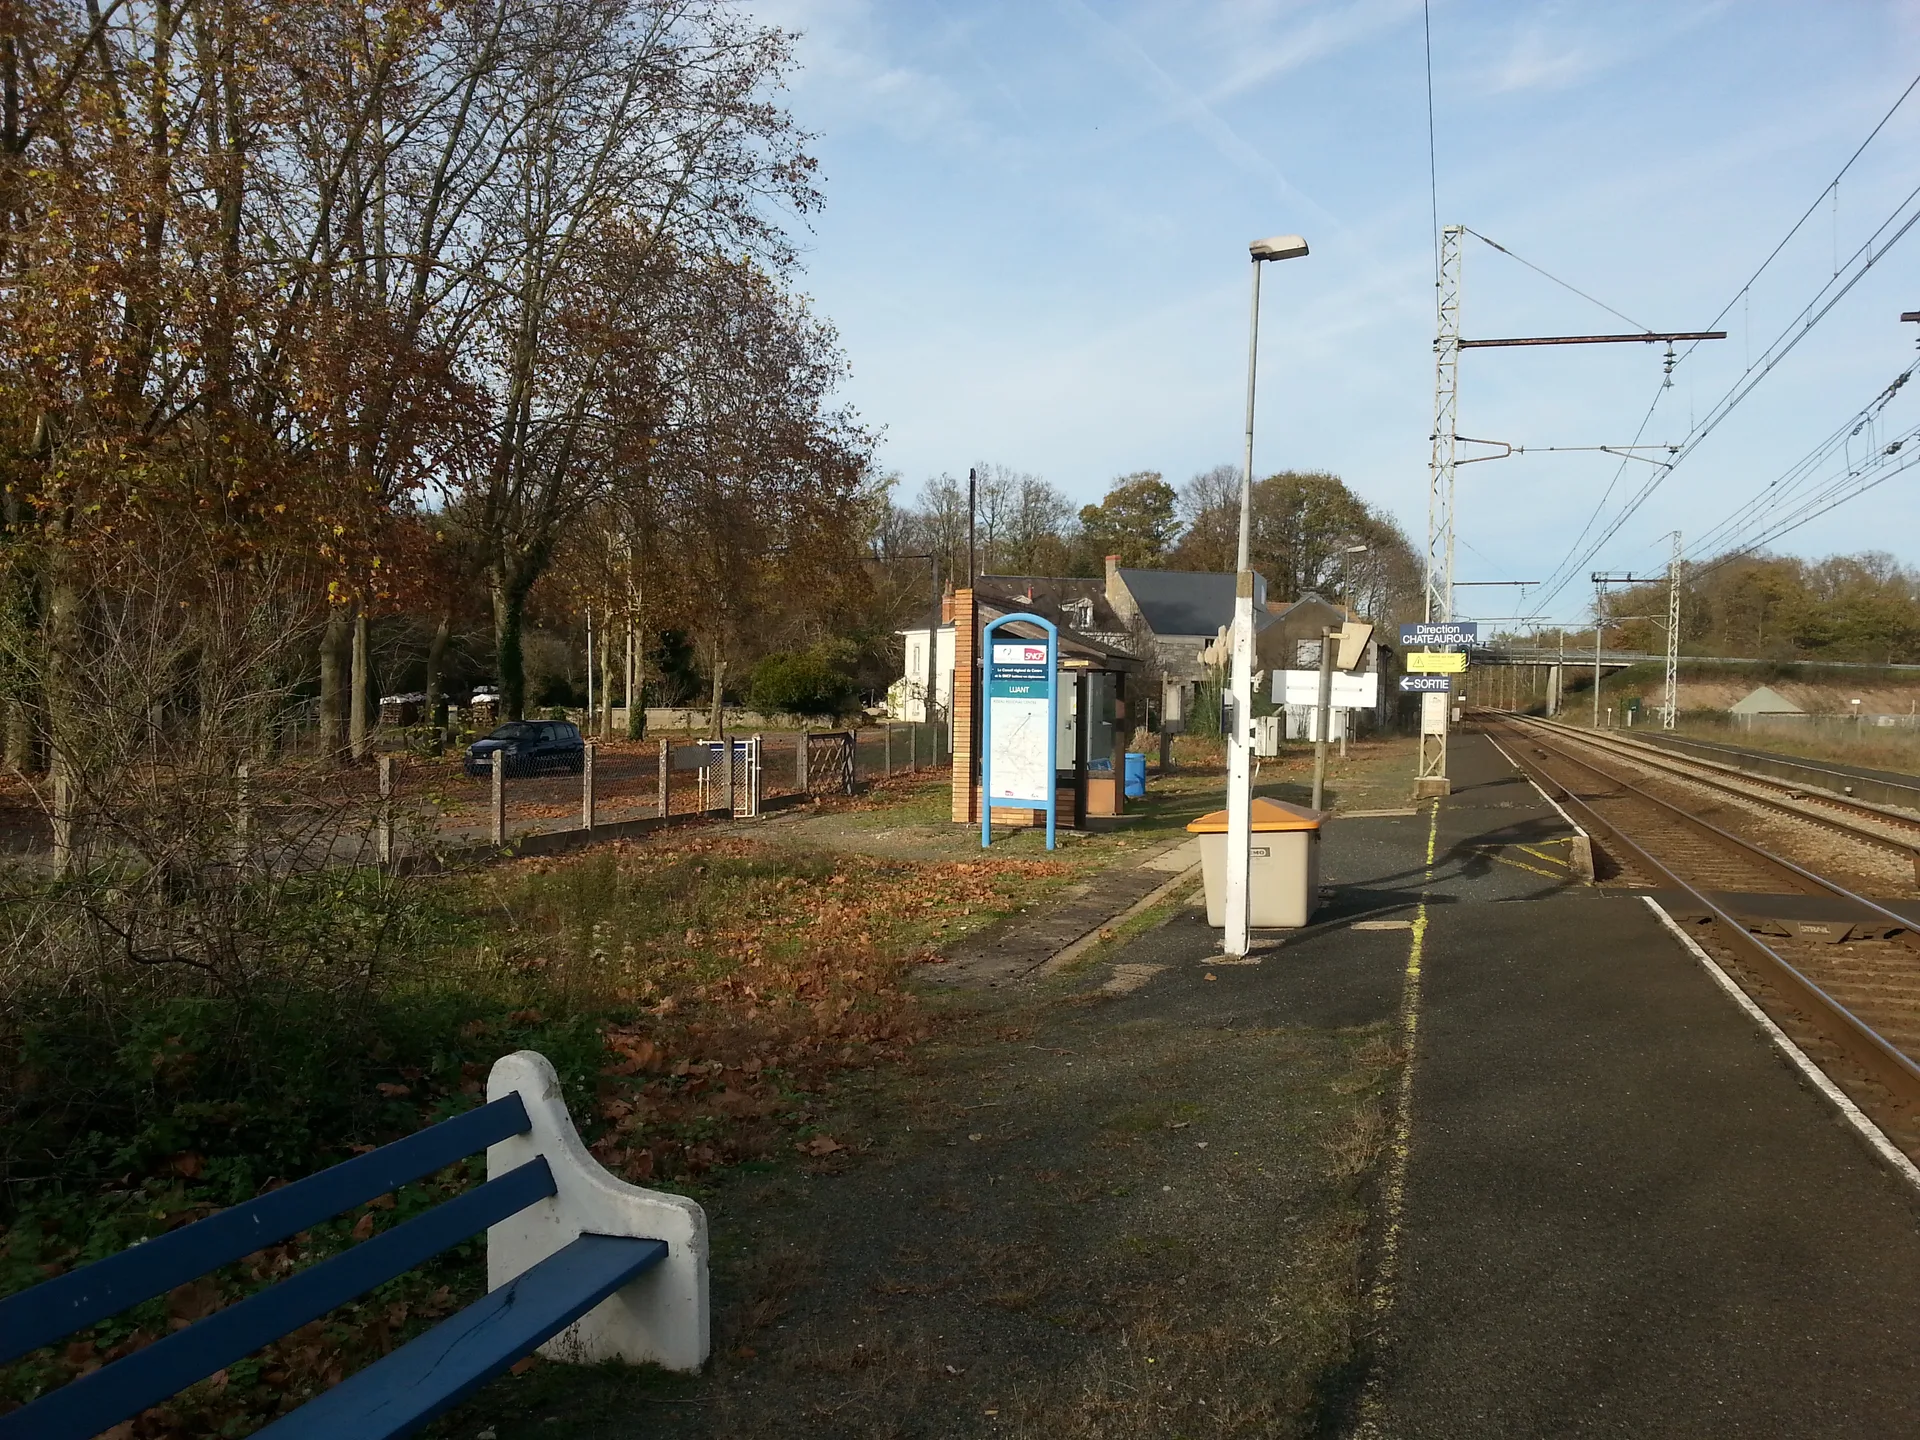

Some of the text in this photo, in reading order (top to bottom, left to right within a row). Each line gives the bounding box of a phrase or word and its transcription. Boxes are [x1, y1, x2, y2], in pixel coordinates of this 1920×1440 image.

[1417, 625, 1460, 634] Direction
[1402, 634, 1475, 644] CHATEAUROUX
[1414, 679, 1449, 689] SORTIE
